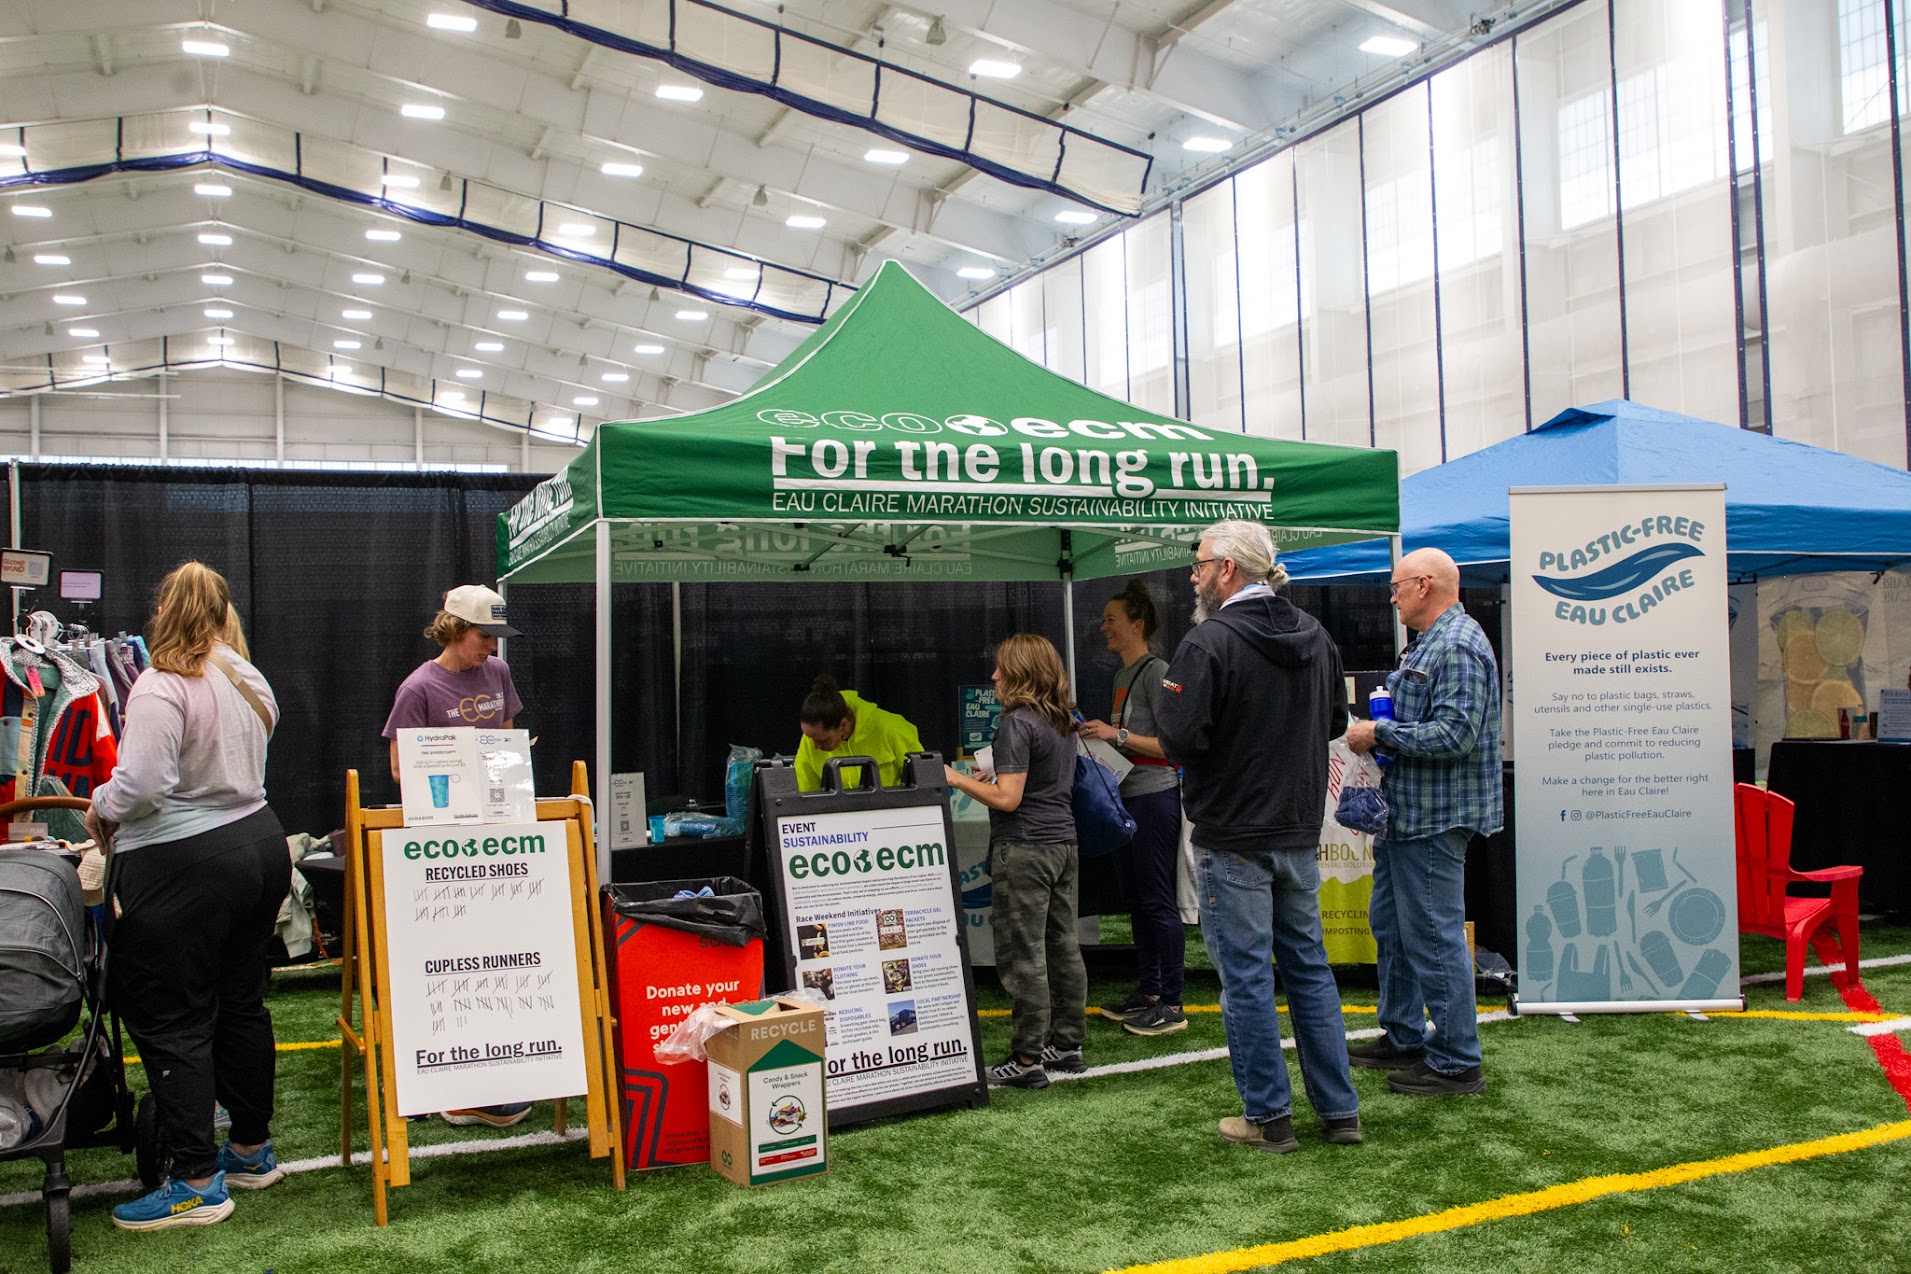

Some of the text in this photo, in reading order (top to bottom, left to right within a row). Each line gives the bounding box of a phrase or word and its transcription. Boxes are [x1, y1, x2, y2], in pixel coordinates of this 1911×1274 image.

[1010, 417, 1215, 440] ecm
[769, 436, 1274, 498] For the long run.
[773, 492, 1275, 519] EAU CLAIRE MARATHON SUSTAINABILITY INITIATIVE
[1539, 515, 1705, 571] PLASTIC-FREE
[1555, 569, 1695, 626] EAU CLAIRE
[1545, 653, 1577, 663] Every
[1581, 652, 1612, 663] piece
[1615, 650, 1628, 660] of
[1632, 650, 1671, 661] plastic
[1573, 664, 1672, 674] made still exists.
[1552, 692, 1569, 702] Say
[1600, 692, 1630, 702] plastic
[1634, 691, 1659, 701] bags,
[1662, 691, 1695, 699] straws,
[446, 708, 460, 719] THE
[1534, 702, 1713, 713] utensils and other single-use plastics.
[1549, 726, 1699, 737] Take the Plastic-Free Eau Claire
[1548, 741, 1582, 751] pledge
[1584, 740, 1602, 748] and
[1605, 740, 1642, 748] commit
[1659, 739, 1701, 748] reducing
[1585, 751, 1665, 762] plastic pollution.
[1542, 777, 1569, 785] Make
[1580, 776, 1614, 786] change
[1618, 775, 1632, 784] for
[1635, 775, 1650, 783] the
[1654, 775, 1683, 783] better
[1686, 774, 1708, 784] right
[1582, 787, 1669, 796] here in Eau Claire!
[1585, 809, 1692, 821] @PlasticFreeEauClaire
[782, 822, 816, 834] EVENT
[403, 834, 546, 860] eco ecm
[783, 831, 869, 848] SUSTAINABILITY
[789, 842, 945, 879] eco ecm
[425, 862, 529, 882] RECYCLED SHOES
[796, 907, 882, 923] Race Weekend Initiatives
[1322, 910, 1369, 919] RECYCLIN
[425, 951, 541, 974] CUPLESS RUNNERS
[646, 980, 740, 999] Donate your
[662, 1004, 694, 1016] new
[751, 1019, 816, 1040] RECYCLE
[415, 1039, 563, 1065] For the long run.
[851, 1050, 883, 1071] the
[889, 1043, 929, 1063] long
[933, 1039, 968, 1056] run.
[417, 1054, 563, 1075] EAU CLAIRE MARATHON SUSTAINABILITY INITIATIVE
[832, 1075, 856, 1086] CLAIRE
[856, 1070, 892, 1081] MARATHON
[892, 1061, 940, 1075] SUSTAINABILITY
[940, 1056, 969, 1066] INITIATIVE
[763, 1075, 783, 1084] Candy
[790, 1071, 808, 1079] Snack
[771, 1080, 801, 1089] Wrappers
[171, 1196, 204, 1215] HOKA
